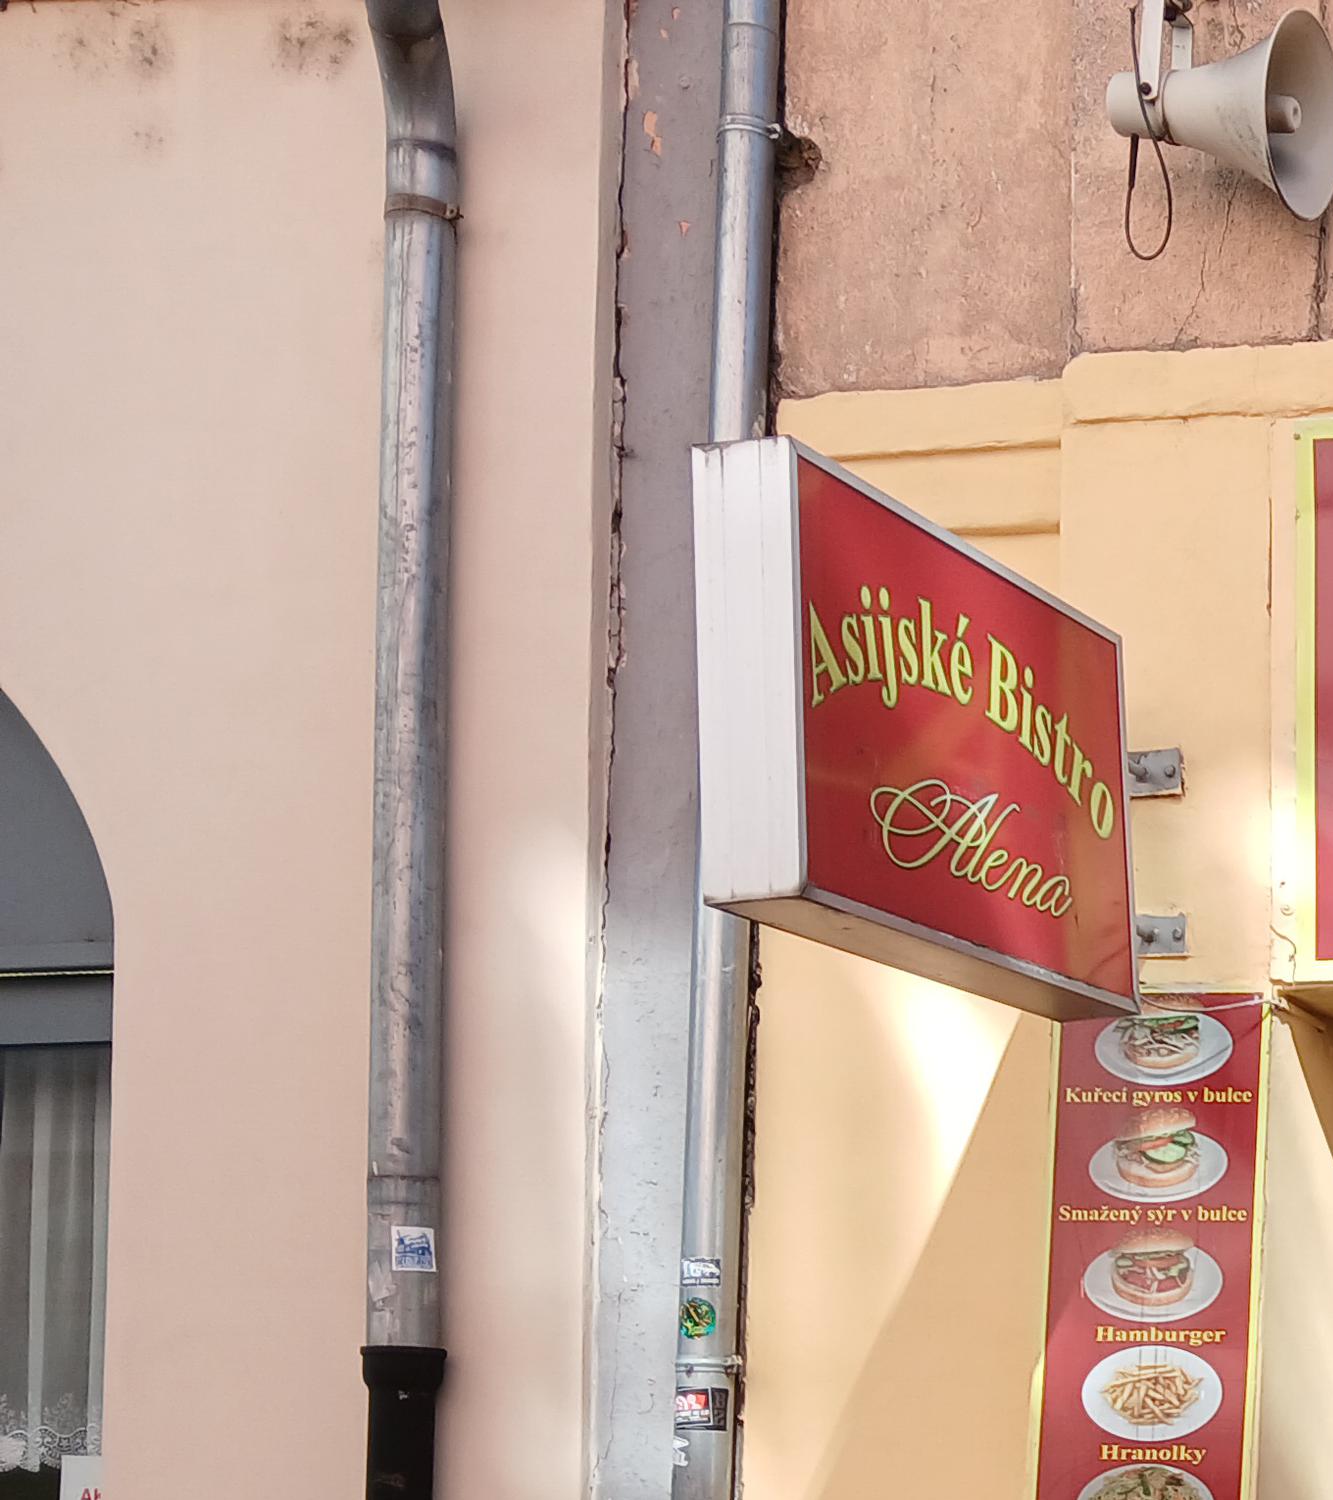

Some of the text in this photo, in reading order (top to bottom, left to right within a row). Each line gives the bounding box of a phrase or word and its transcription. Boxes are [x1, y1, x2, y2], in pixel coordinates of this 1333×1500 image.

[809, 585, 1114, 839] Asijské Bistro
[870, 779, 1073, 918] Alena
[1065, 1086, 1128, 1103] Kuřecí
[1132, 1091, 1182, 1107] gyros
[1203, 1086, 1253, 1103] bulce
[1058, 1205, 1143, 1226] Smažený
[1147, 1209, 1177, 1226] sýr
[1197, 1205, 1248, 1222] bulce
[1096, 1326, 1226, 1347] Hamburger
[1100, 1444, 1207, 1465] Hranolky
